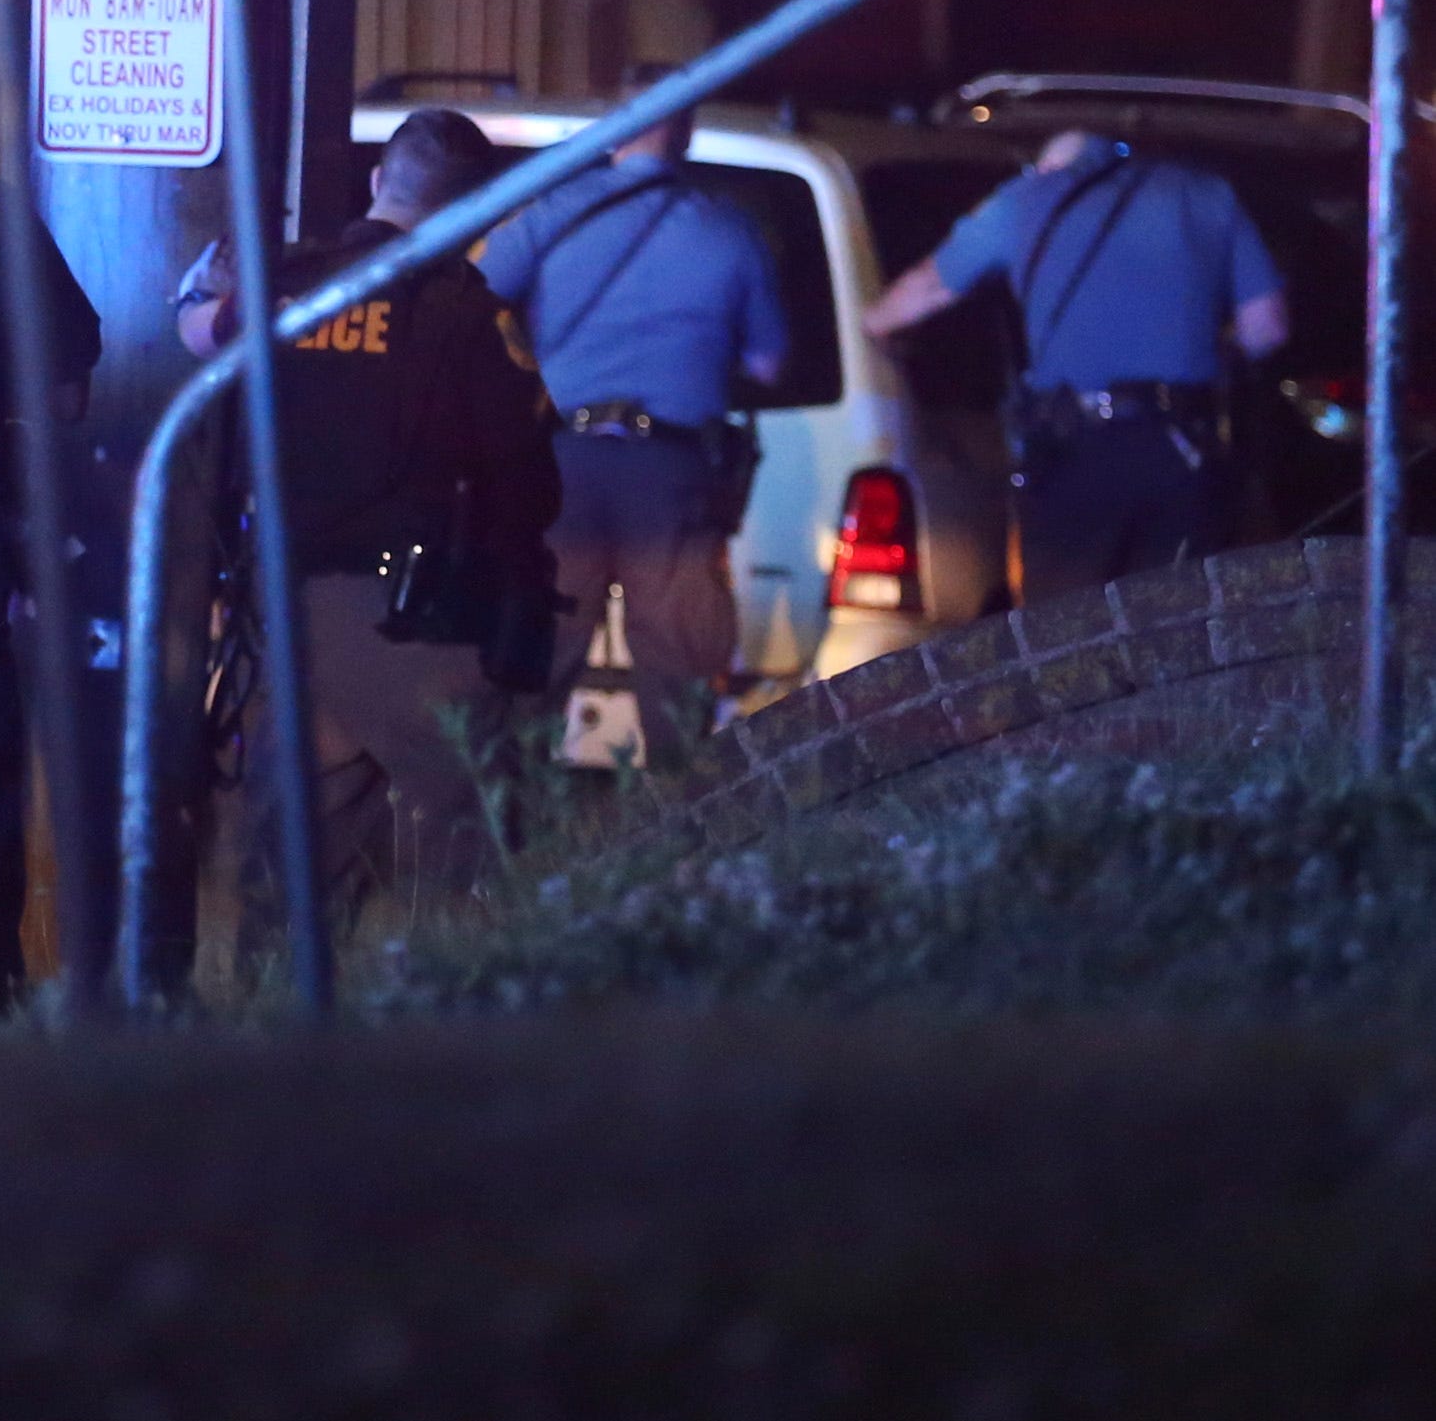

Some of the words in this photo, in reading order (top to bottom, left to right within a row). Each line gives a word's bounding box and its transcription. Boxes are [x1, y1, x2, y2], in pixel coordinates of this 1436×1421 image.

[82, 29, 172, 57] STREET
[71, 61, 185, 88] CLEANING
[48, 94, 75, 113] EX
[81, 96, 184, 116] HOLIDAYS
[192, 100, 205, 116] &
[48, 123, 89, 141] NOV
[158, 126, 203, 144] MAR
